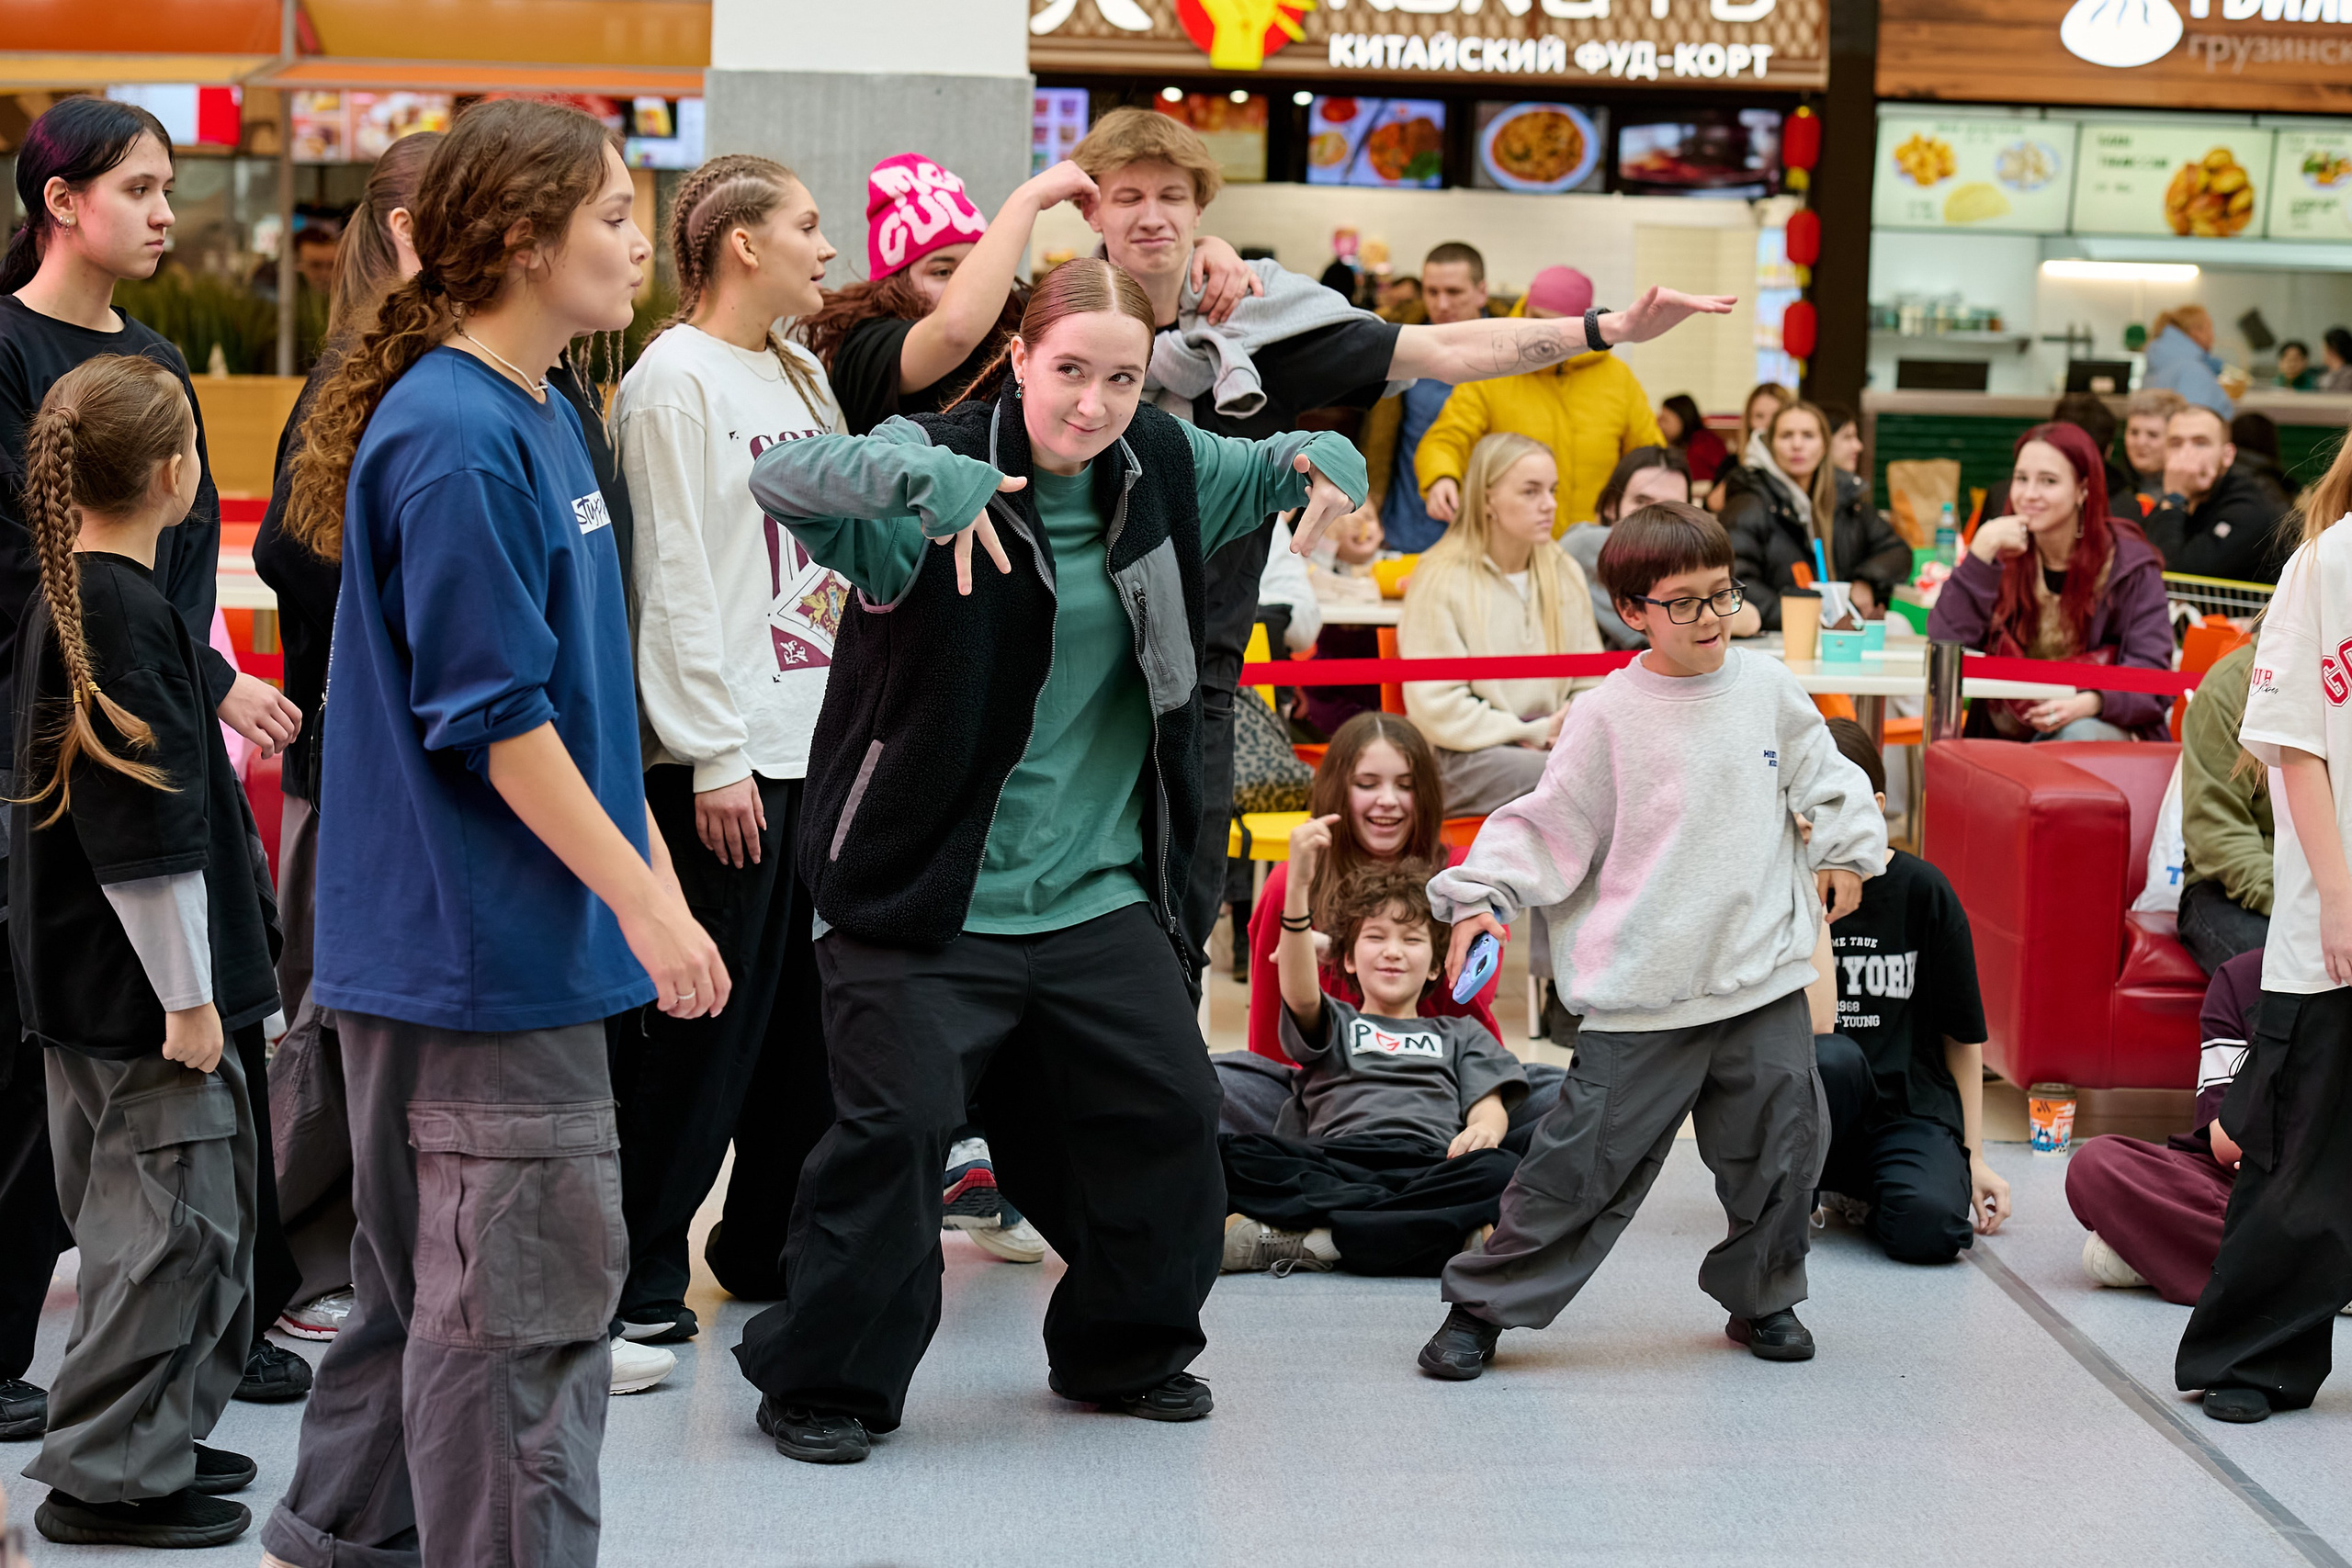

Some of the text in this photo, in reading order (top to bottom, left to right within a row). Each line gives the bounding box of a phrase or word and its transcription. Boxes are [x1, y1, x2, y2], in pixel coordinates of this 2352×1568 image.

[1329, 31, 1773, 81] КИТАЙСКИЙ ФУД-КОРТ
[1849, 937, 1878, 949] TRUE
